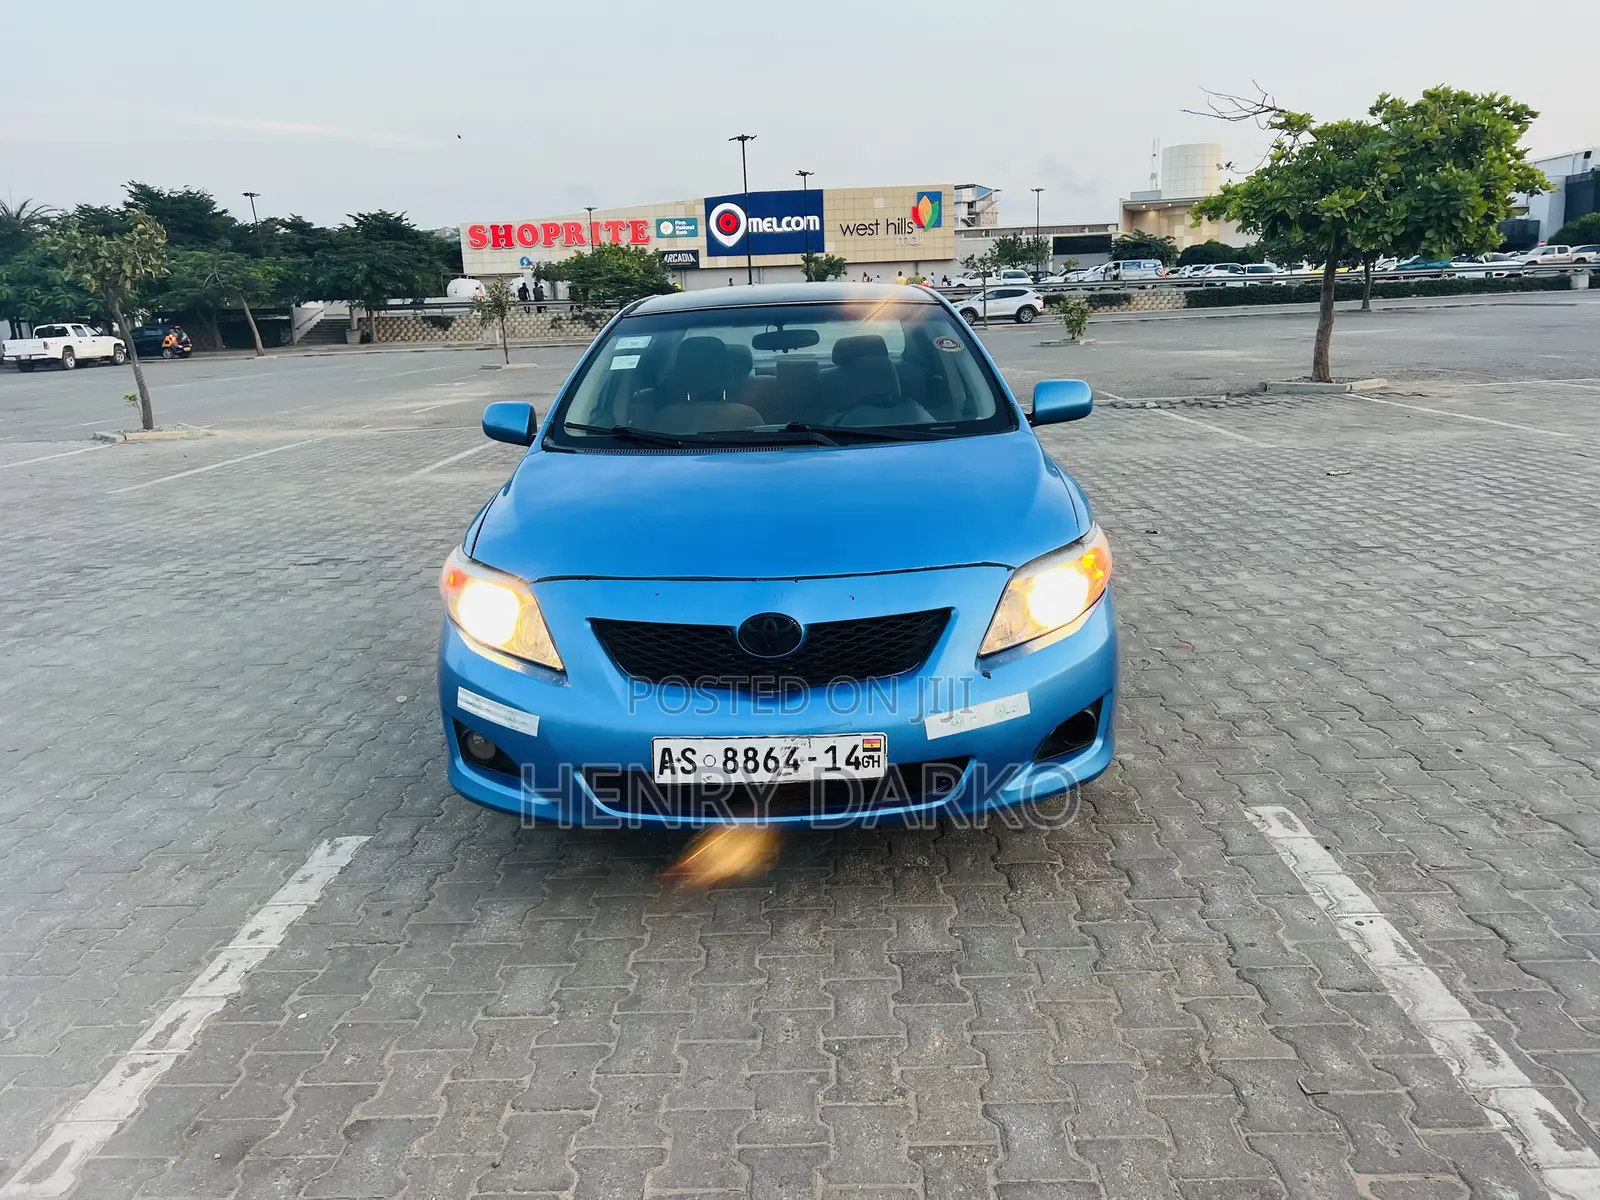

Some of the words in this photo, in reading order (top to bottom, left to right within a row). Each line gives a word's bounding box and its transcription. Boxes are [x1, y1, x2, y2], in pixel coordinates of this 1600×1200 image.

[467, 219, 651, 249] SHOPRITE
[840, 219, 880, 236] west
[886, 218, 914, 235] hills
[662, 253, 696, 263] ARCADIA
[861, 754, 881, 769] GH
